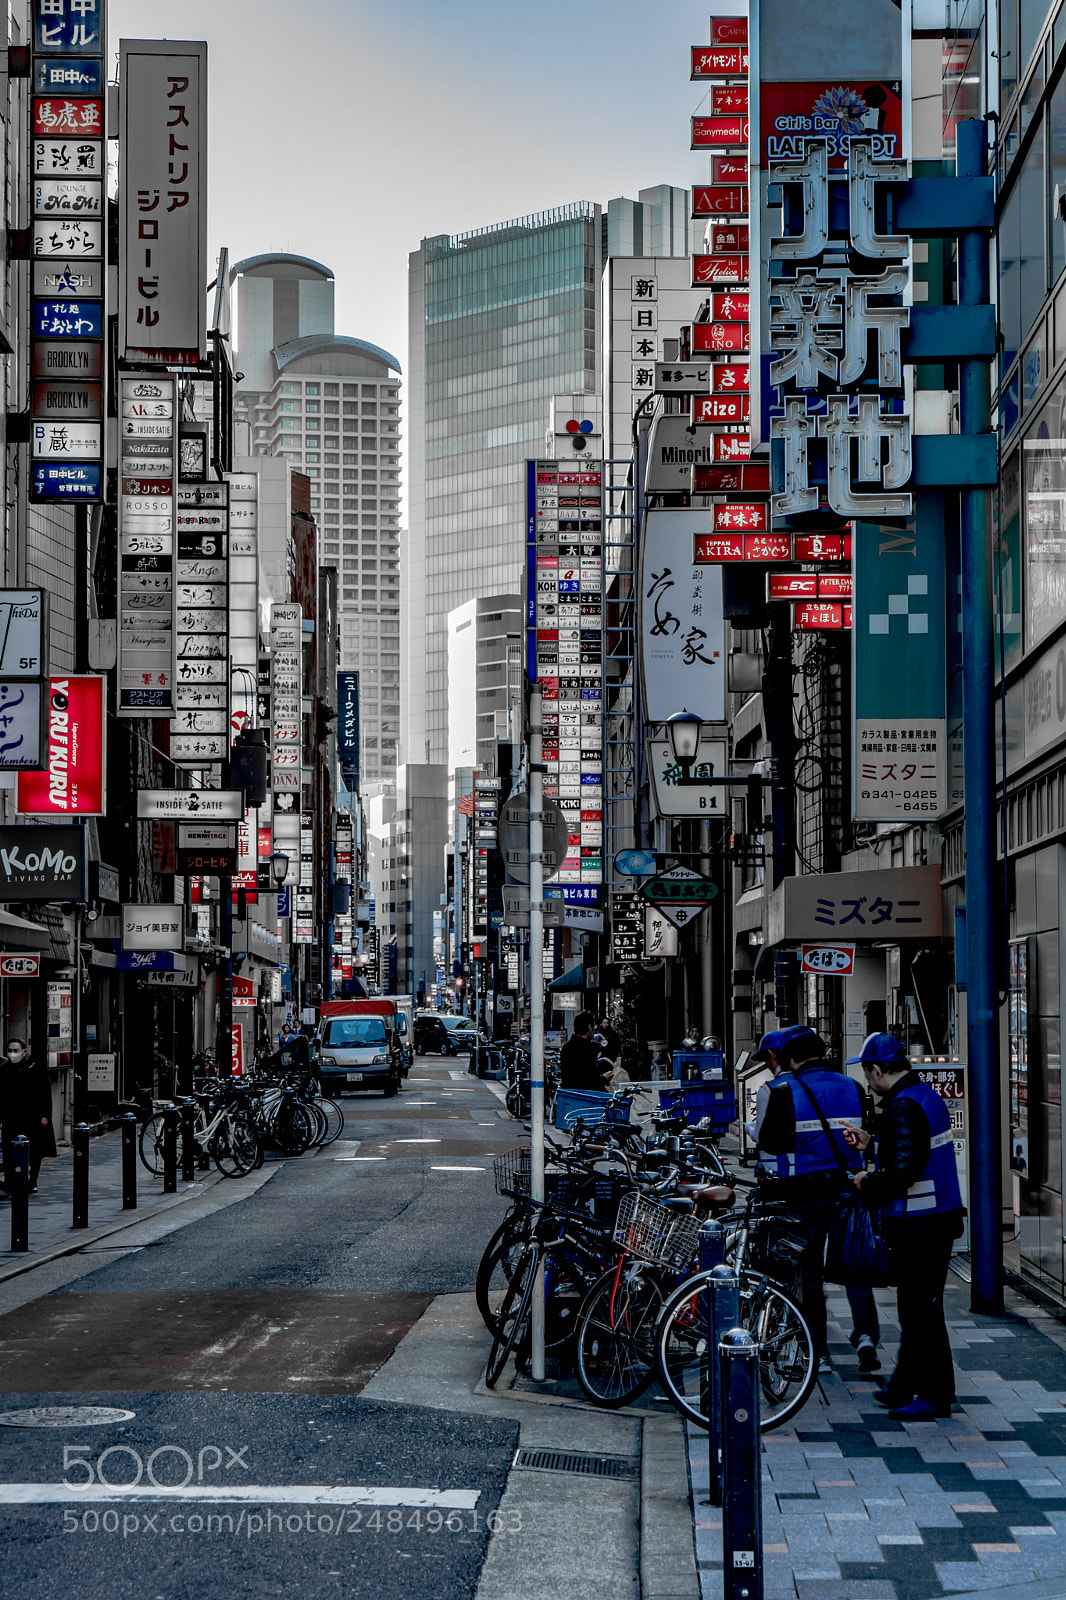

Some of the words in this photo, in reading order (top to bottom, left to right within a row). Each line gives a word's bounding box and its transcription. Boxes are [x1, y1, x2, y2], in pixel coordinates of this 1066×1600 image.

[41, 22, 98, 46] ビル
[700, 55, 737, 67] ダイヤモンド
[892, 81, 900, 92] 4
[776, 117, 811, 129] Girl's
[815, 117, 839, 129] Bar
[694, 129, 740, 139] Ganymede
[167, 76, 189, 213] アストリア
[769, 137, 836, 156] LADS
[839, 136, 895, 155] SOT
[36, 144, 45, 170] 3F
[48, 232, 95, 252] ちから
[716, 233, 736, 244] 金魚
[137, 190, 159, 327] ジロービル
[44, 275, 92, 287] NASH
[41, 307, 49, 330] 1F
[769, 138, 913, 517] 北新地
[705, 340, 734, 348] LINO
[47, 351, 89, 369] BROOKLYN
[661, 370, 710, 383] 喜多一ビ
[47, 391, 89, 409] BROOKLYN
[702, 401, 736, 417] Rize
[49, 427, 70, 452] 蔵
[49, 470, 86, 480] 田中ビル
[126, 502, 169, 511] ROSSO
[697, 546, 742, 557] AKIRA
[752, 546, 789, 558] さかぐち
[538, 582, 556, 591] KOH
[560, 582, 579, 591] ゆき
[800, 612, 840, 623] 月とほし
[19, 658, 37, 669] 5F
[344, 676, 356, 747] ニューウメダビル
[861, 763, 937, 781] ミズタニ
[273, 775, 298, 786] DANA
[872, 790, 938, 799] 341-0425
[156, 801, 182, 809] INSIDE
[201, 801, 223, 810] SATIE
[699, 796, 717, 809] B1
[7, 875, 45, 883] LIVING
[53, 874, 72, 882] BAR
[814, 897, 922, 926] ミズタニ
[126, 922, 179, 933] ジョイ美容室
[807, 949, 847, 968] たばこ
[5, 959, 33, 972] たばこ
